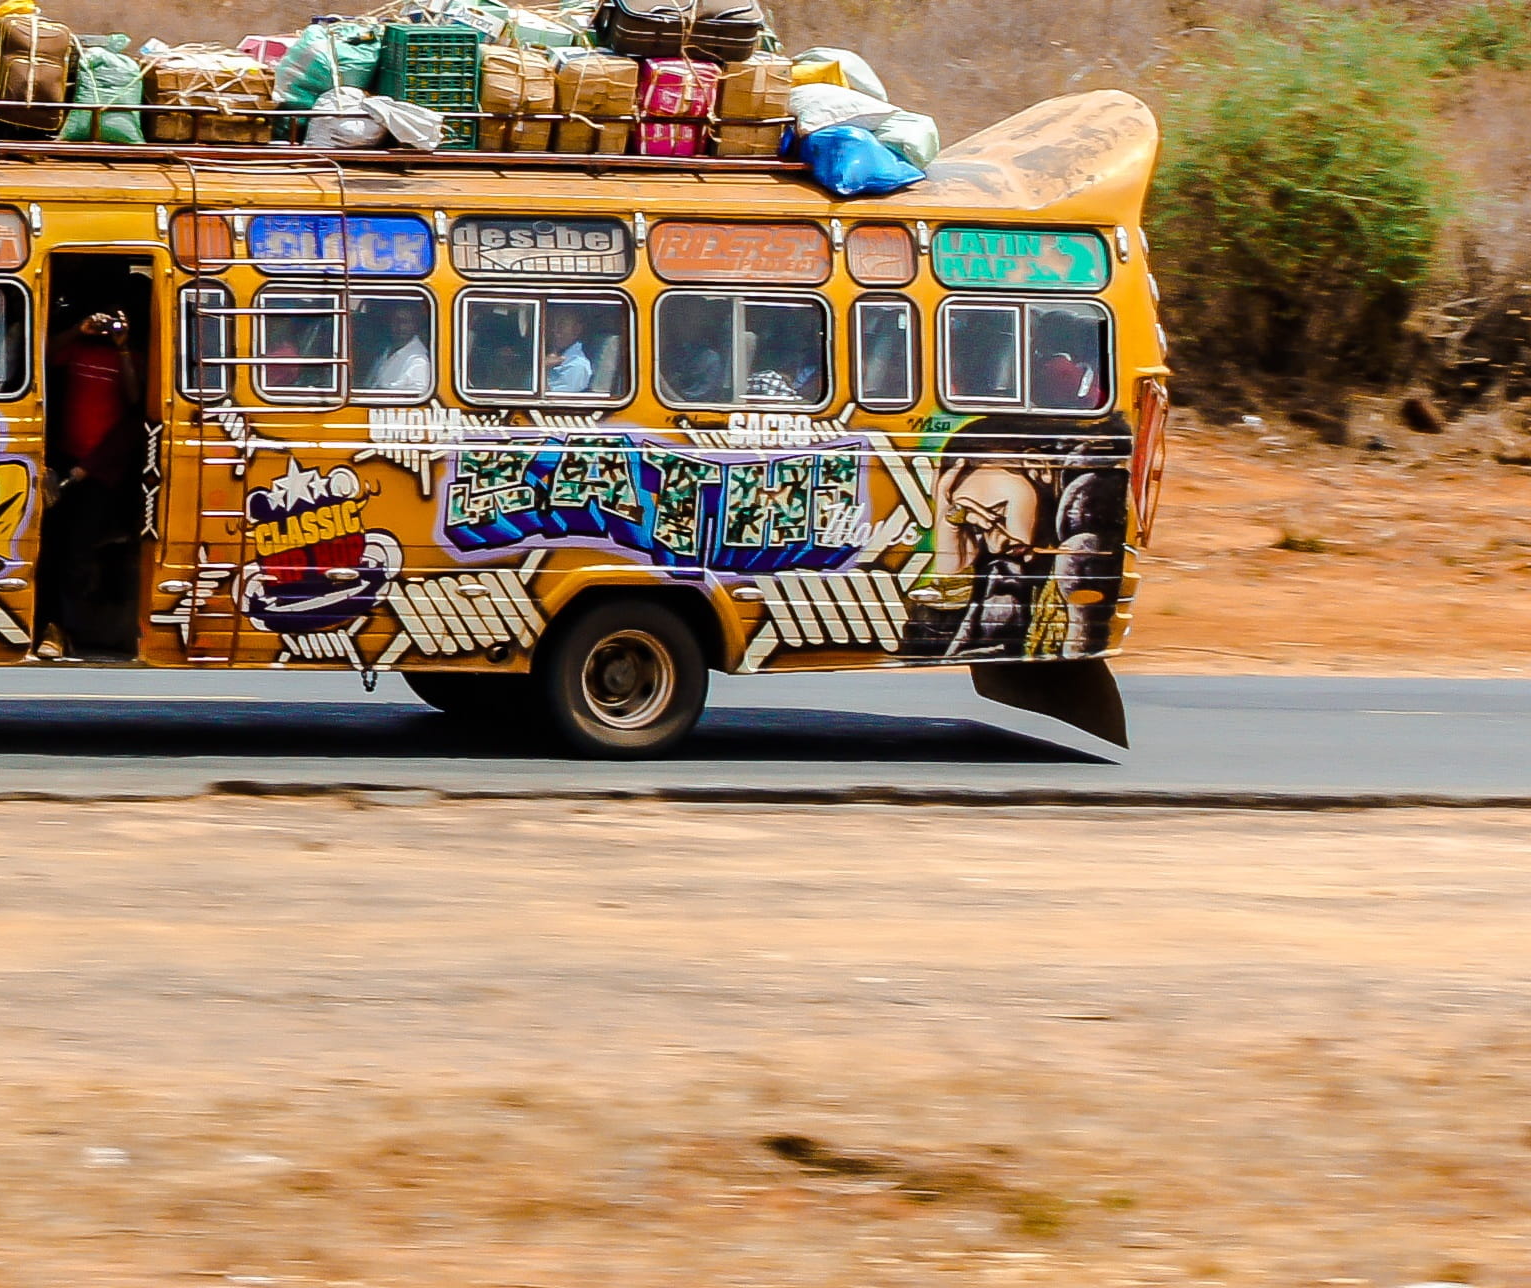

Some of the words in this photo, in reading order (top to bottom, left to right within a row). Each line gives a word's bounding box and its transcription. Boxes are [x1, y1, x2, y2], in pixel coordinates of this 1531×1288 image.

[452, 221, 626, 253] desibel
[657, 226, 819, 260] RIDERS
[939, 232, 1041, 256] LATIN
[941, 257, 1016, 279] RAP
[254, 500, 360, 557] CLASSIC
